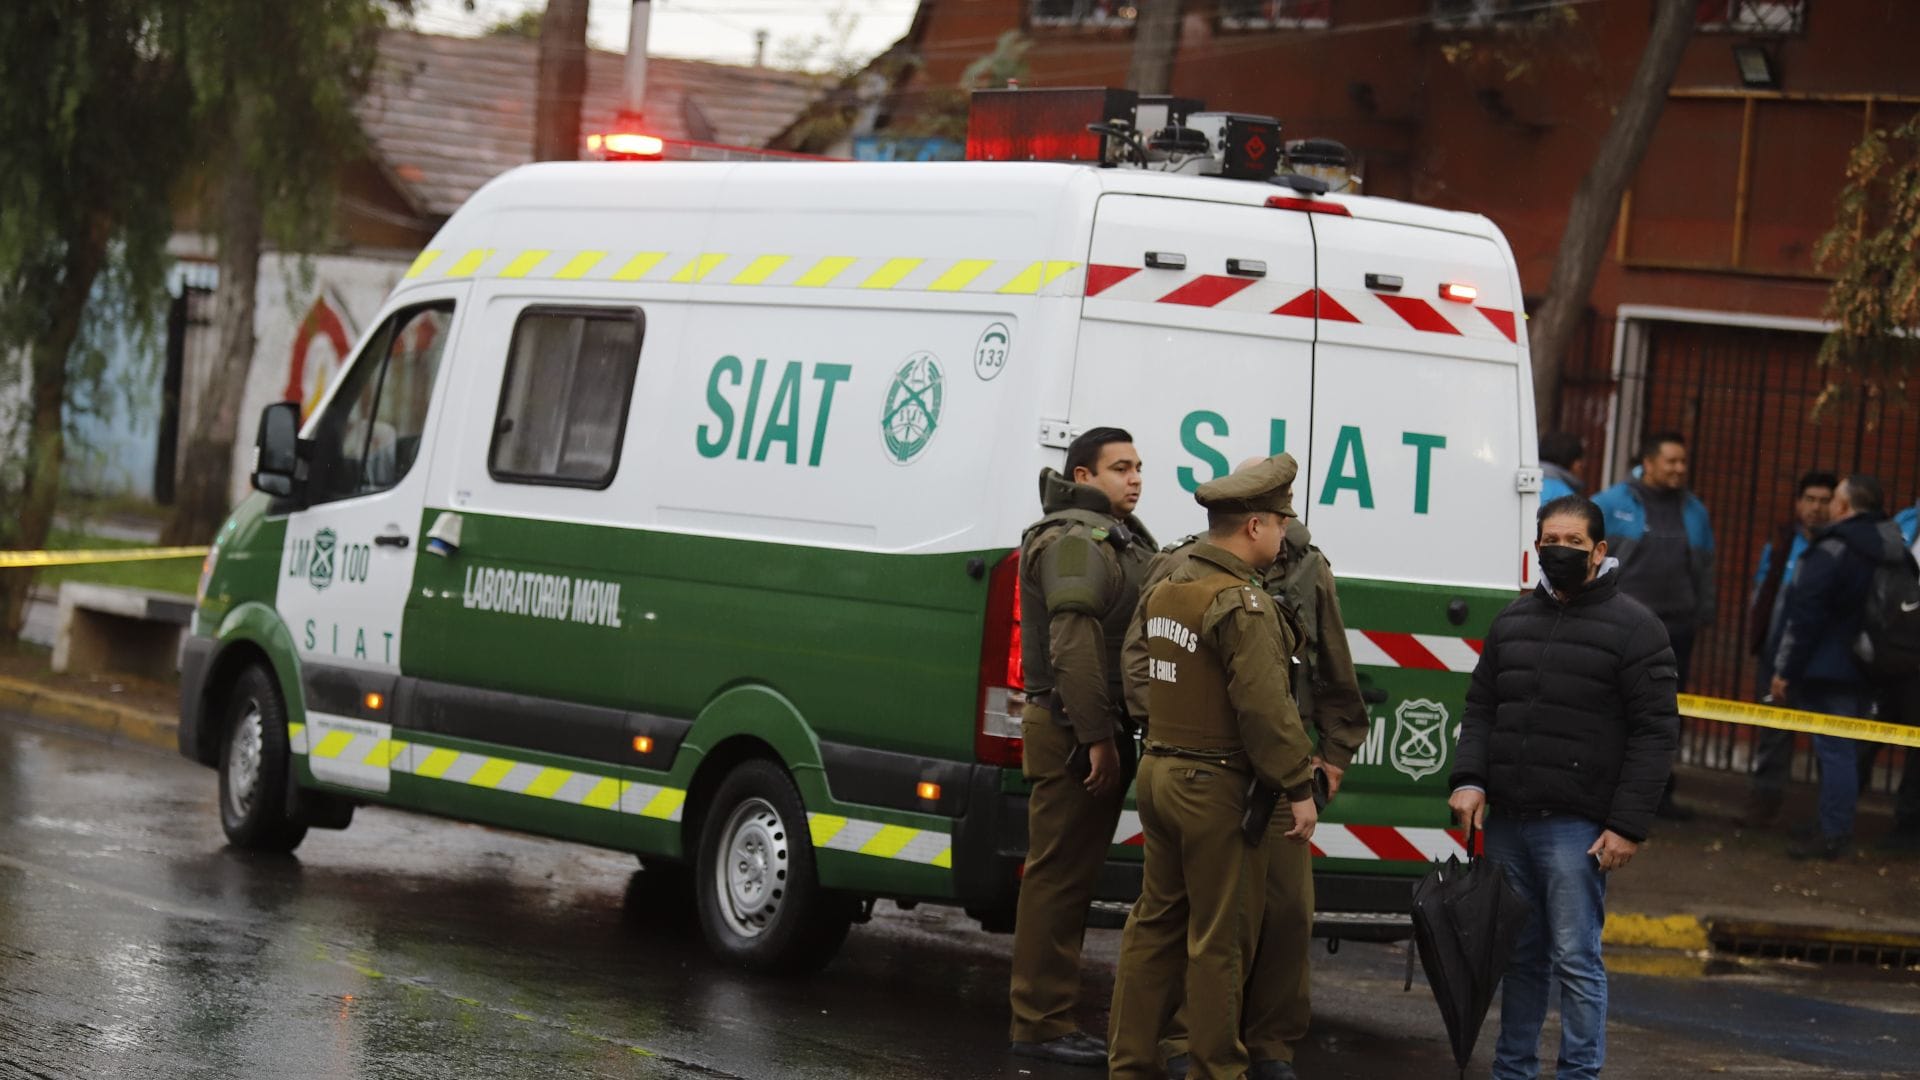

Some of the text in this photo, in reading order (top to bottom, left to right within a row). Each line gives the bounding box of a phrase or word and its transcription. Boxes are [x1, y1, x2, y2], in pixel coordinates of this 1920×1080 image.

[979, 349, 1004, 367] 133
[696, 355, 852, 467] SIAT
[289, 538, 371, 583] LM 100
[463, 565, 622, 628] LABORATORIO MOVIL
[305, 618, 393, 664] SIAT
[1147, 616, 1198, 653] RABINEROS
[1156, 659, 1177, 683] CHILE
[1350, 716, 1386, 765] M
